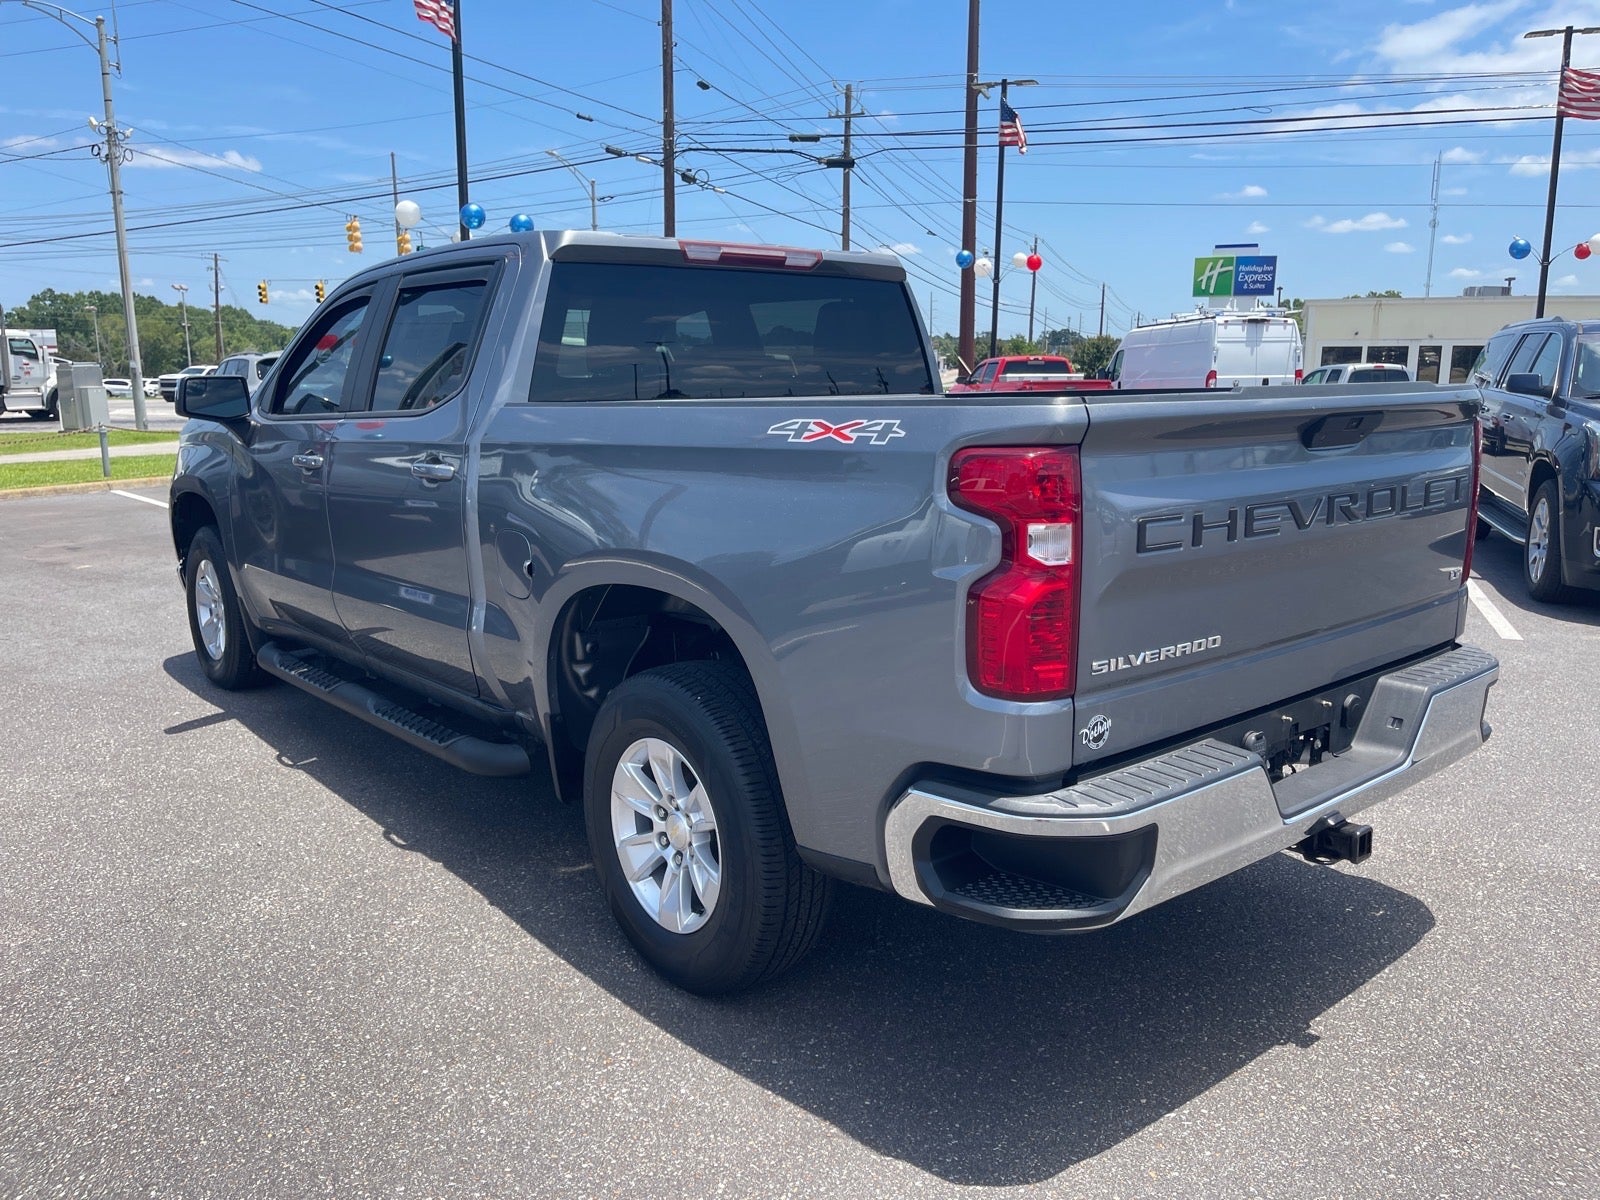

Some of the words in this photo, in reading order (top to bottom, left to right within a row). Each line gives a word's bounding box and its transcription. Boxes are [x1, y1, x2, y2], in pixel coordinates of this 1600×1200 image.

[1238, 272, 1273, 283] Express
[1239, 265, 1262, 273] Holiday
[1136, 474, 1469, 554] CHEVROLET
[1091, 635, 1222, 675] SILVERADO
